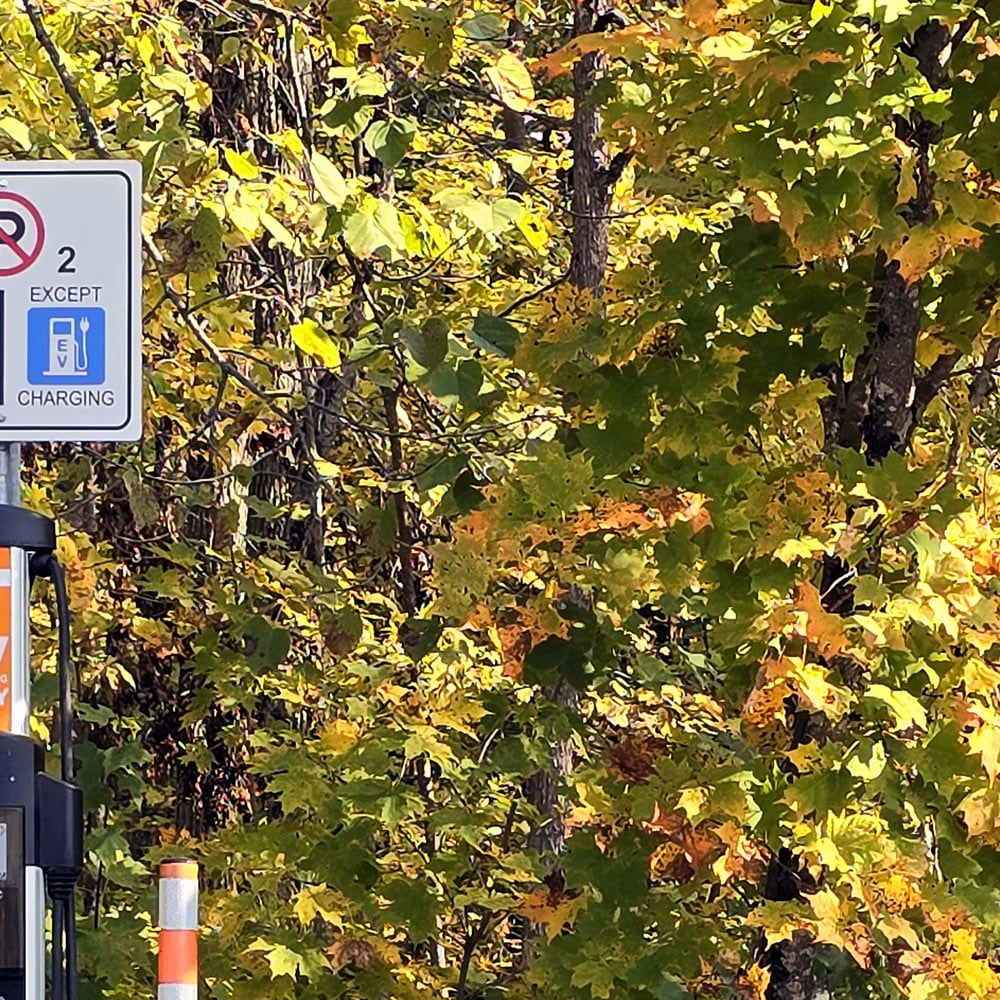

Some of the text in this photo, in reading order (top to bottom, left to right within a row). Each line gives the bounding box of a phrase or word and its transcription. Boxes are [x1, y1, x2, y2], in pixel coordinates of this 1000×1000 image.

[57, 246, 76, 274] 2
[30, 286, 103, 303] EXCEPT
[17, 390, 115, 406] CHARGING
